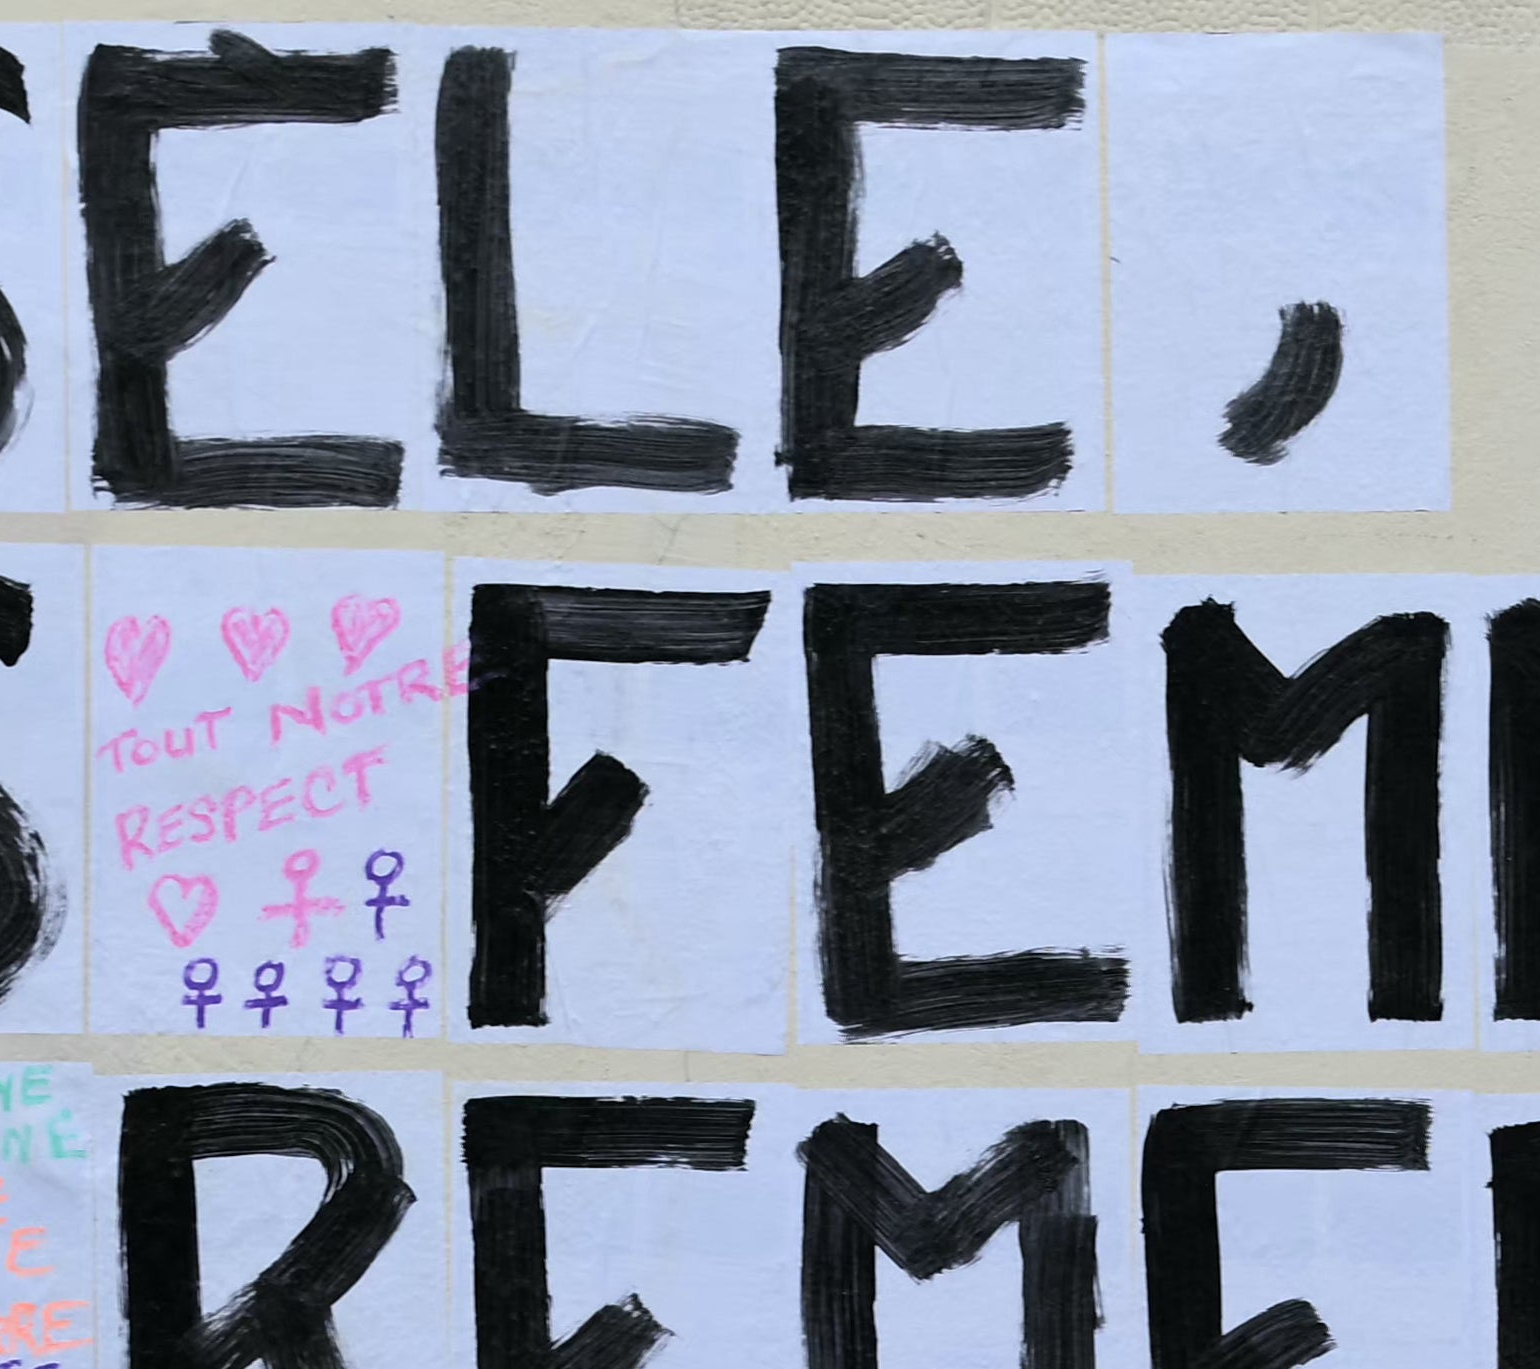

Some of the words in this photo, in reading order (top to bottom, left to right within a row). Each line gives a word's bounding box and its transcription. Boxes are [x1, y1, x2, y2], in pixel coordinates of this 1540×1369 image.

[97, 705, 233, 773] TOUT
[269, 635, 474, 747] NOTRE
[114, 744, 388, 871] RESPECT
